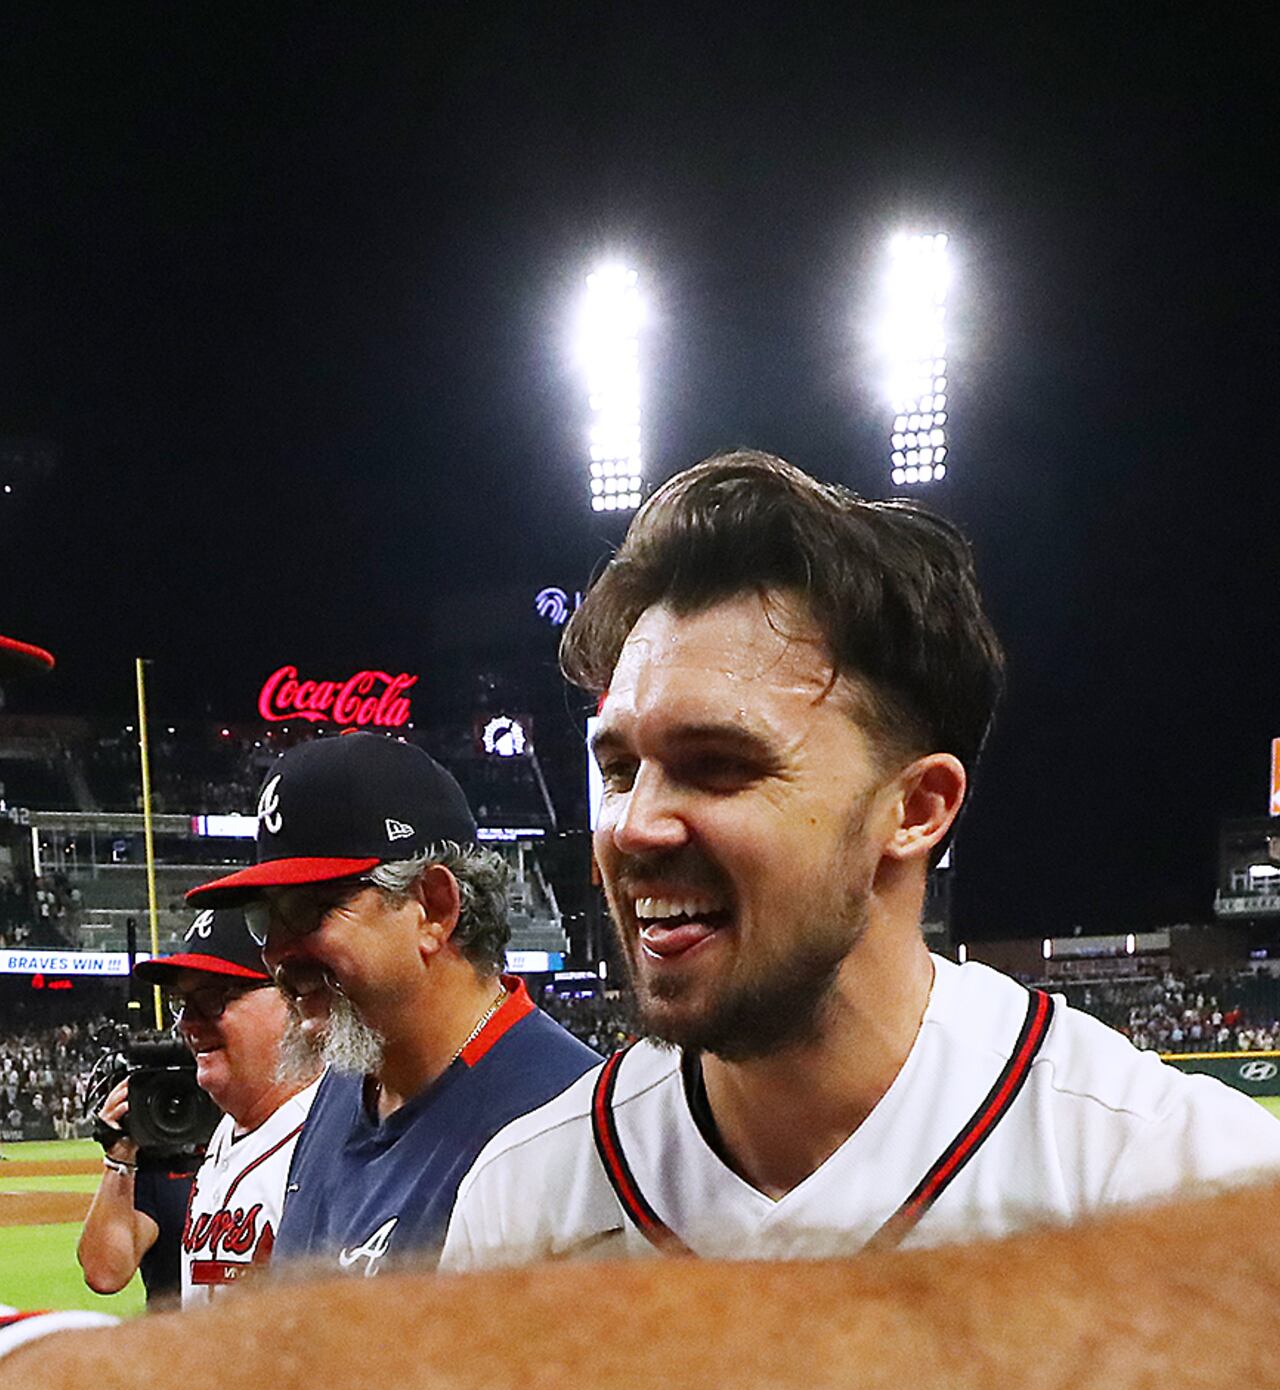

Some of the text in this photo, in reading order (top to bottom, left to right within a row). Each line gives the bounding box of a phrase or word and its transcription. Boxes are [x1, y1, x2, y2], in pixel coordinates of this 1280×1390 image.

[257, 664, 419, 727] Coca-Cola
[7, 956, 69, 971] BRAVES
[73, 957, 105, 971] WIN
